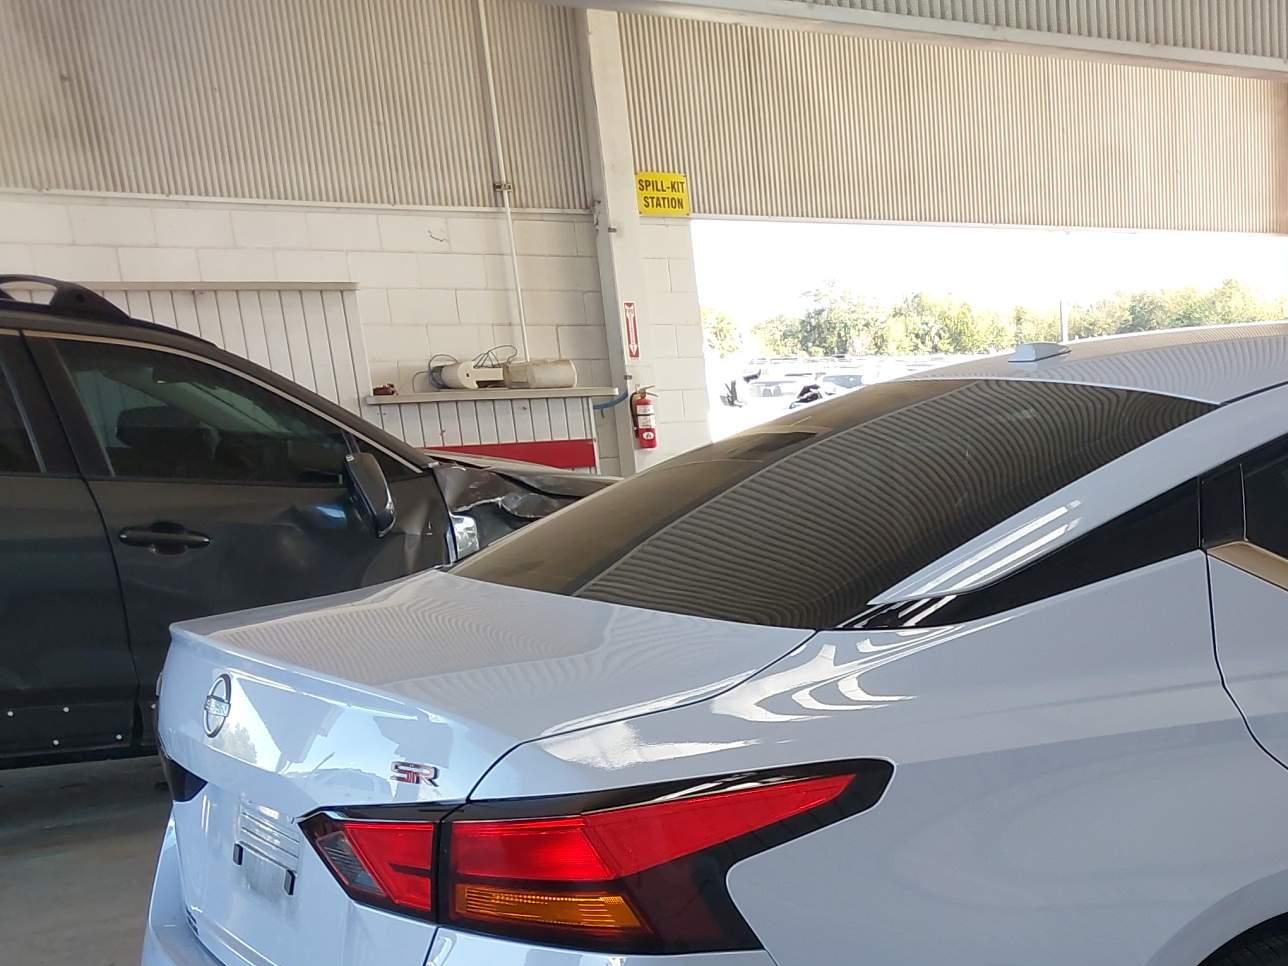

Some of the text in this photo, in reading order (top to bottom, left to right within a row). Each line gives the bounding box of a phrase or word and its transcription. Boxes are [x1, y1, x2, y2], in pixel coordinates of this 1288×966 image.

[638, 179, 685, 193] SPILL-KIT
[643, 196, 684, 209] STATION
[391, 761, 440, 786] SR
